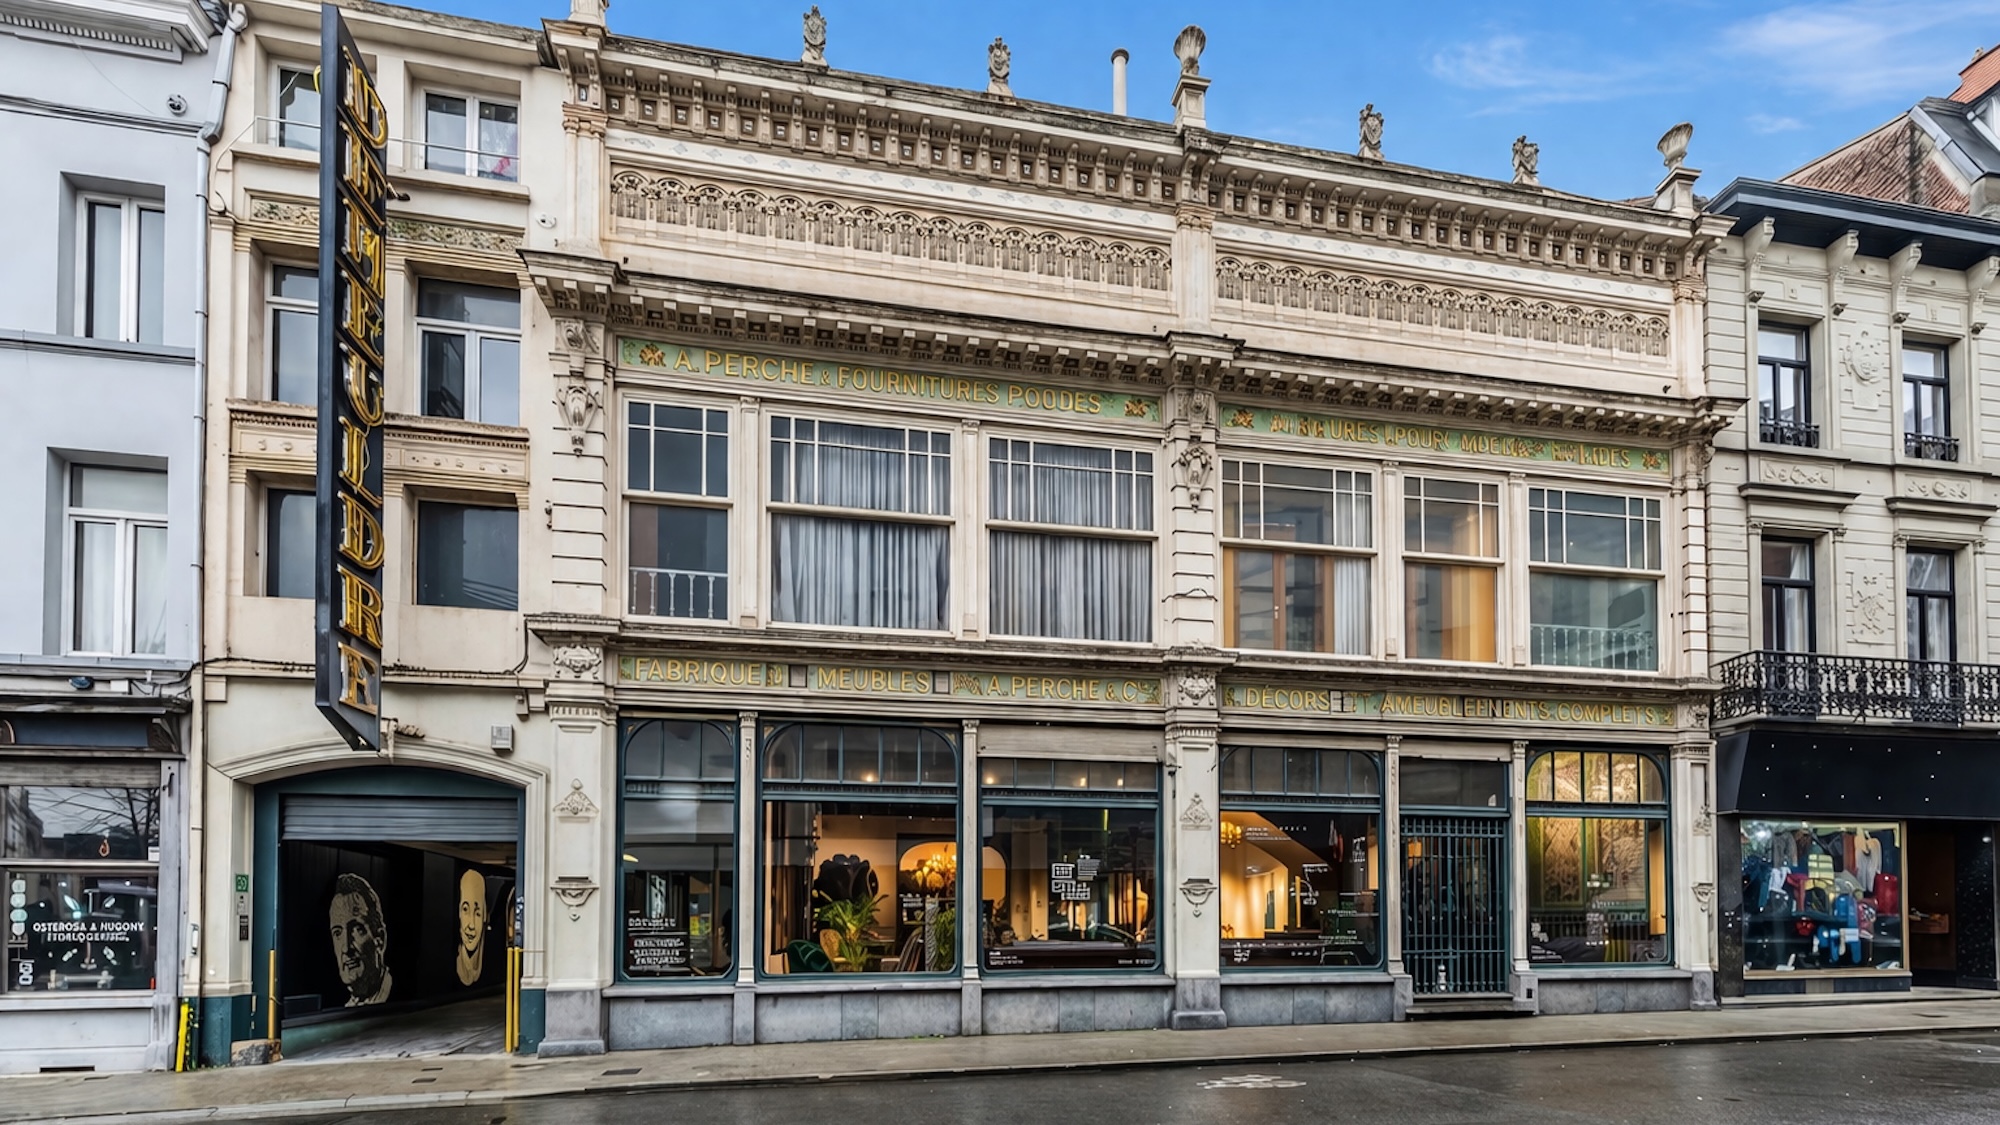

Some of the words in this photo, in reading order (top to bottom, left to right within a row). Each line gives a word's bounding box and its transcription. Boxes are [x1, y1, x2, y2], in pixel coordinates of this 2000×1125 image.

[704, 350, 816, 386] PERCHE
[820, 368, 832, 386] &
[836, 366, 1000, 404] FOURNITURES
[634, 657, 762, 686] FABRIQUE
[817, 667, 930, 694] MEUBLES
[1011, 675, 1100, 700] PERCHE
